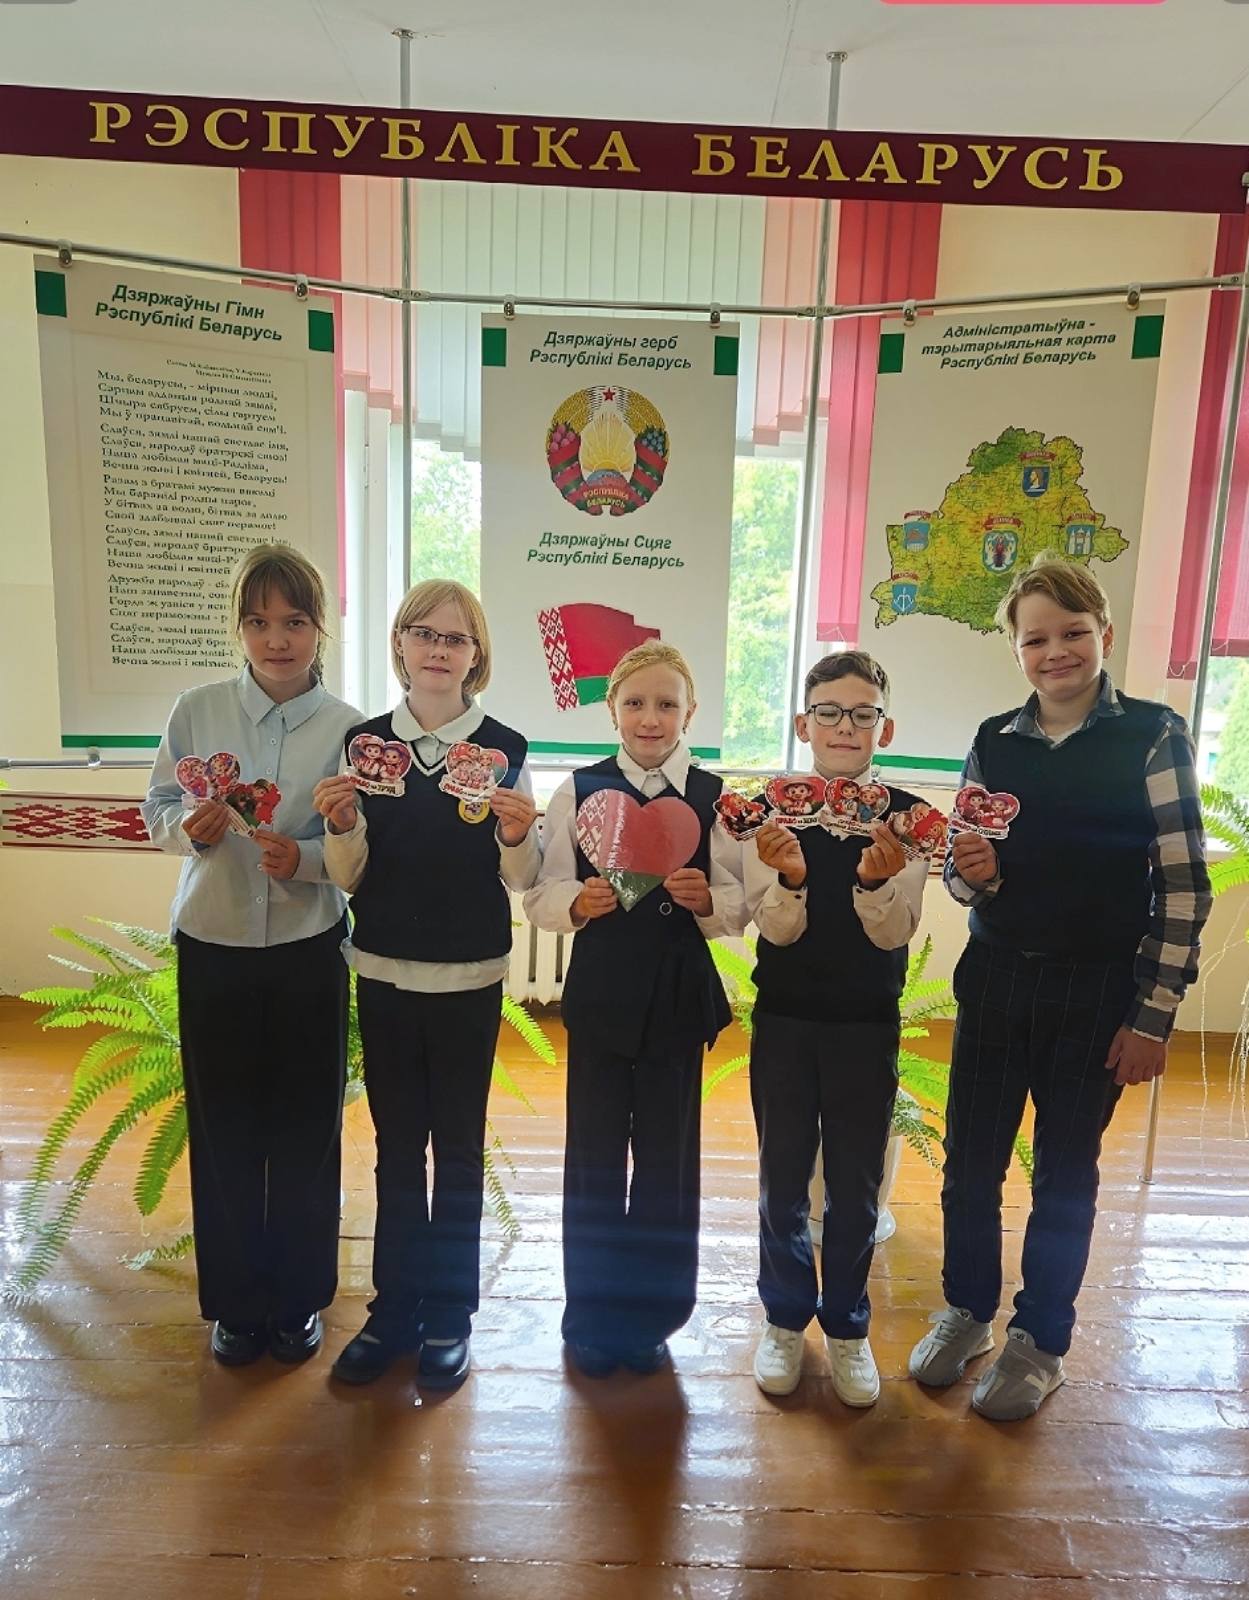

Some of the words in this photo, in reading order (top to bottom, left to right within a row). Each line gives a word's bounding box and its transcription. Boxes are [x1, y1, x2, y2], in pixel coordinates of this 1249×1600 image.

[88, 101, 641, 174] РЭСПУБЛІКА
[692, 133, 1127, 192] БЕЛАРУСЬ
[112, 284, 220, 313] Дзяржаўны
[225, 301, 265, 319] Гімн
[95, 302, 194, 329] Рэспублікі
[199, 317, 283, 341] Беларусь
[943, 319, 1085, 339] Адміністратыўна
[544, 332, 636, 349] Дзяржаўны
[640, 336, 678, 349] герб
[921, 337, 1062, 356] тэрытарыяльная
[1066, 334, 1116, 347] карта
[530, 350, 613, 368] Рэспублікі
[618, 353, 691, 370] Беларусь
[940, 354, 1019, 370] Рэспублікі
[1023, 351, 1096, 365] Беларусь
[98, 370, 124, 382] Мы,
[100, 407, 121, 416] Мы
[540, 533, 629, 547] Дзяржаўны
[634, 535, 671, 549] Сцяг
[527, 550, 608, 565] Рэспублікі
[612, 552, 685, 568] Беларусь
